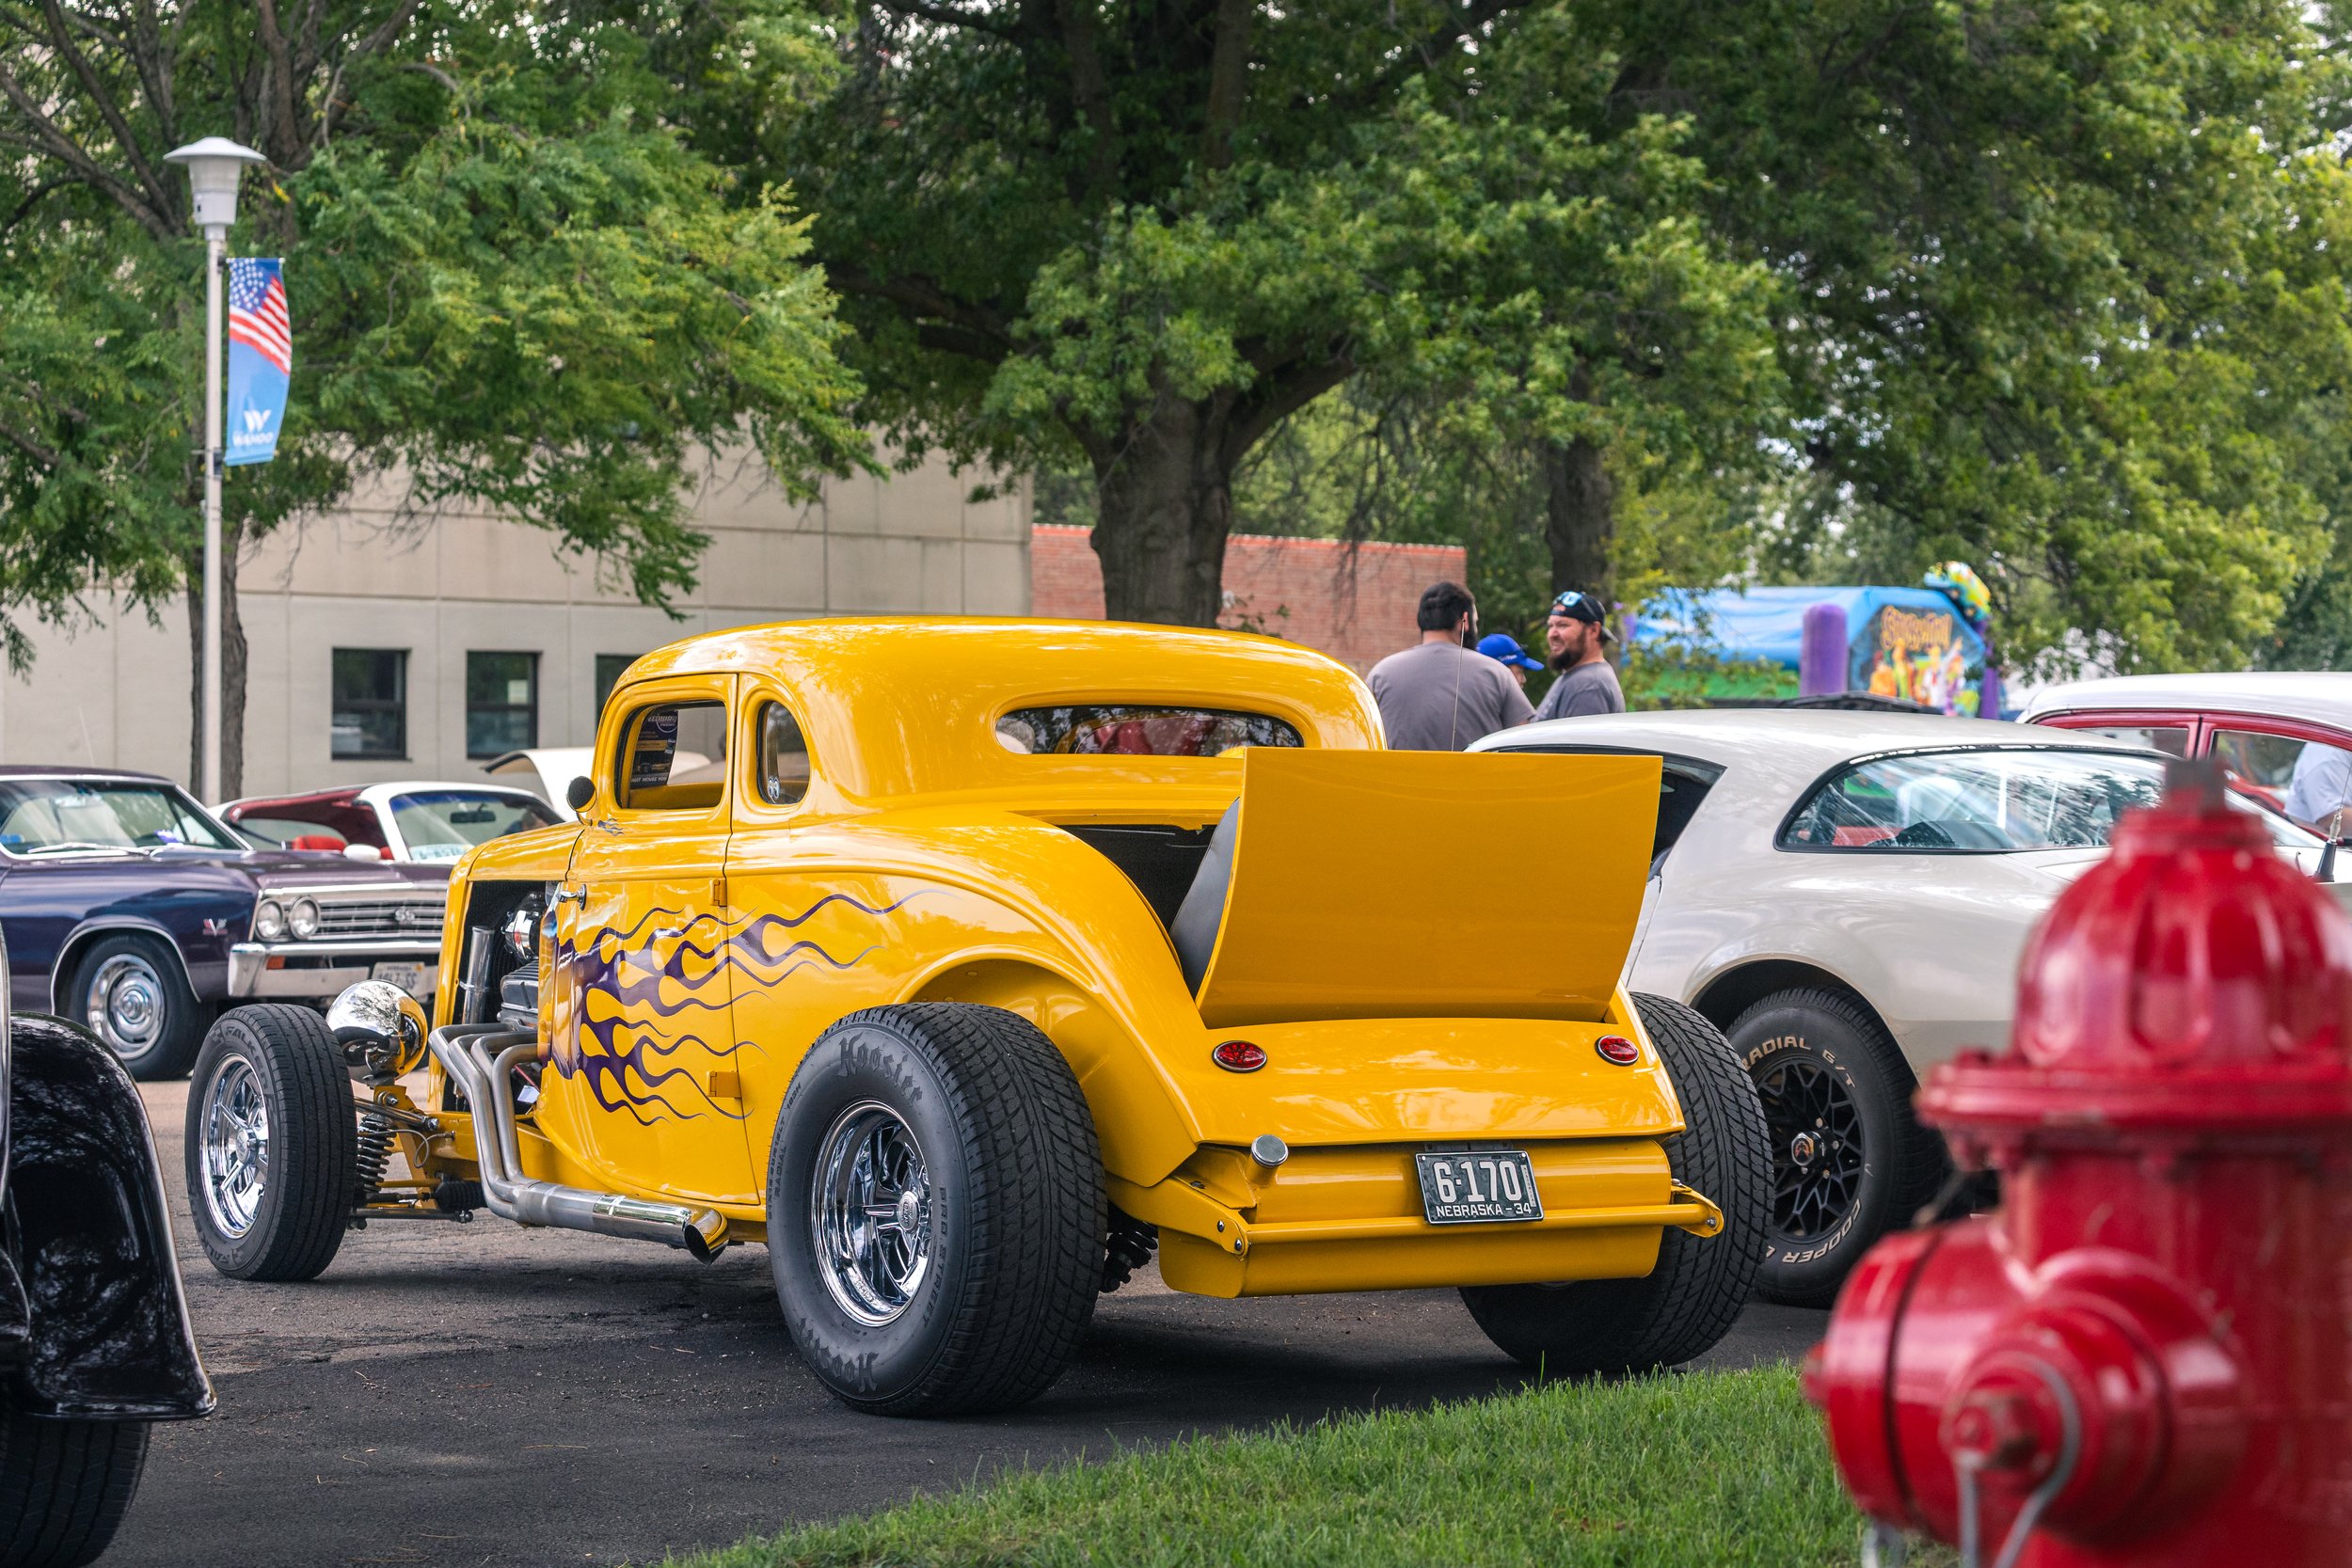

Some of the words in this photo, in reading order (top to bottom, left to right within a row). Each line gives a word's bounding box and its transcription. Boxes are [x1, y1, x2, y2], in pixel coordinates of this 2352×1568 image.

[836, 1031, 923, 1106] Hoosier
[1436, 1203, 1503, 1218] NEBRASKA
[1782, 1198, 1862, 1263] COOPER
